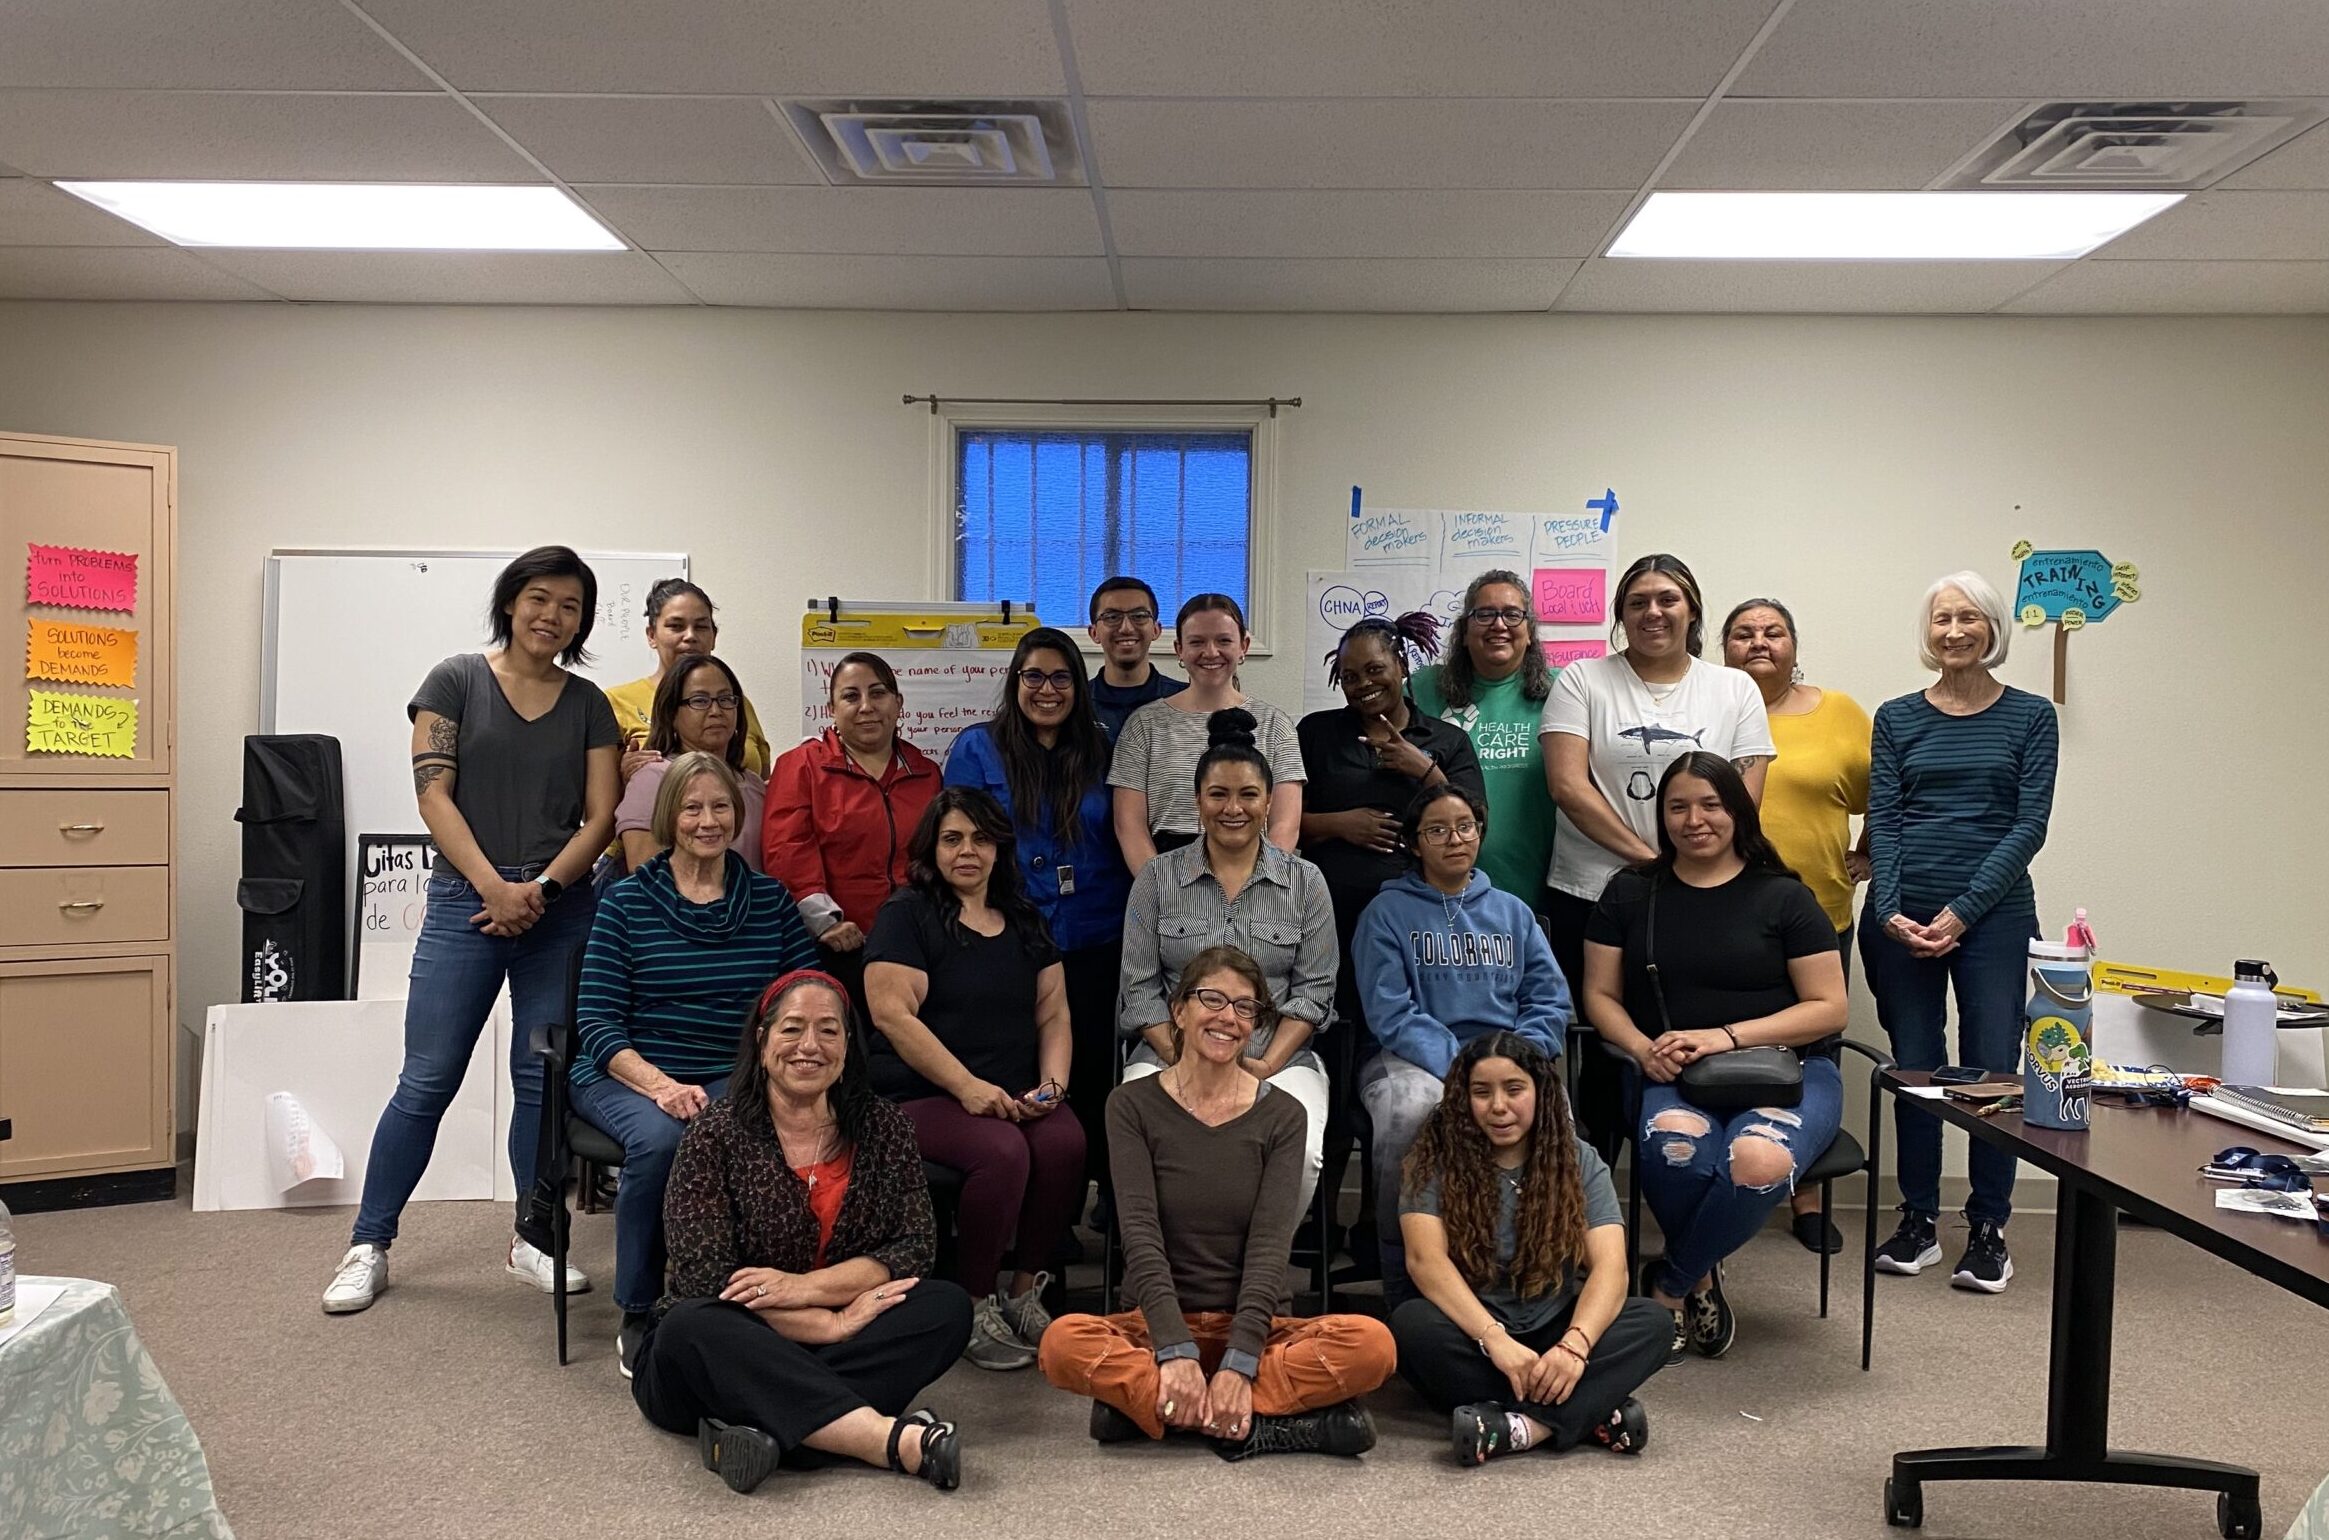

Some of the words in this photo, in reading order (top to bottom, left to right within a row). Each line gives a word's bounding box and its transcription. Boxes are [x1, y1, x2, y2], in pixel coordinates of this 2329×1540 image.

[1351, 513, 1410, 538] FORMAL
[1454, 512, 1509, 528] INFORMAL
[1544, 518, 1599, 535] PRESSURE
[1383, 532, 1427, 553] makers
[1451, 525, 1502, 542] decision
[1467, 534, 1514, 549] makers
[1554, 531, 1602, 549] PEOPLE
[33, 552, 62, 566] turn
[69, 554, 134, 572] PROBLEMS
[59, 572, 85, 582] into
[37, 582, 126, 603] SOLUTIONS
[1542, 578, 1595, 601] Board
[2022, 564, 2106, 610] TRAINING
[1324, 600, 1362, 615] CHNA
[1542, 600, 1567, 615] Local
[47, 628, 118, 645] SOLUTIONS
[57, 647, 101, 660] become
[40, 660, 108, 676] DEMANDS
[806, 659, 818, 676] 1)
[908, 667, 941, 676] name
[943, 665, 956, 675] of
[962, 667, 985, 683] your
[44, 699, 117, 718] DEMANDS
[804, 704, 818, 721] 2)
[916, 711, 935, 726] you
[938, 707, 959, 719] feel
[907, 726, 929, 739] your
[1478, 722, 1531, 734] HEALTH
[38, 730, 116, 748] TARGET
[1477, 732, 1530, 748] CARE
[1479, 747, 1530, 760] RIGHT
[364, 844, 414, 879] Citas
[363, 878, 407, 908] para
[366, 903, 391, 931] de
[1410, 931, 1514, 969] COLORADO
[2026, 1045, 2059, 1093] CORVUS
